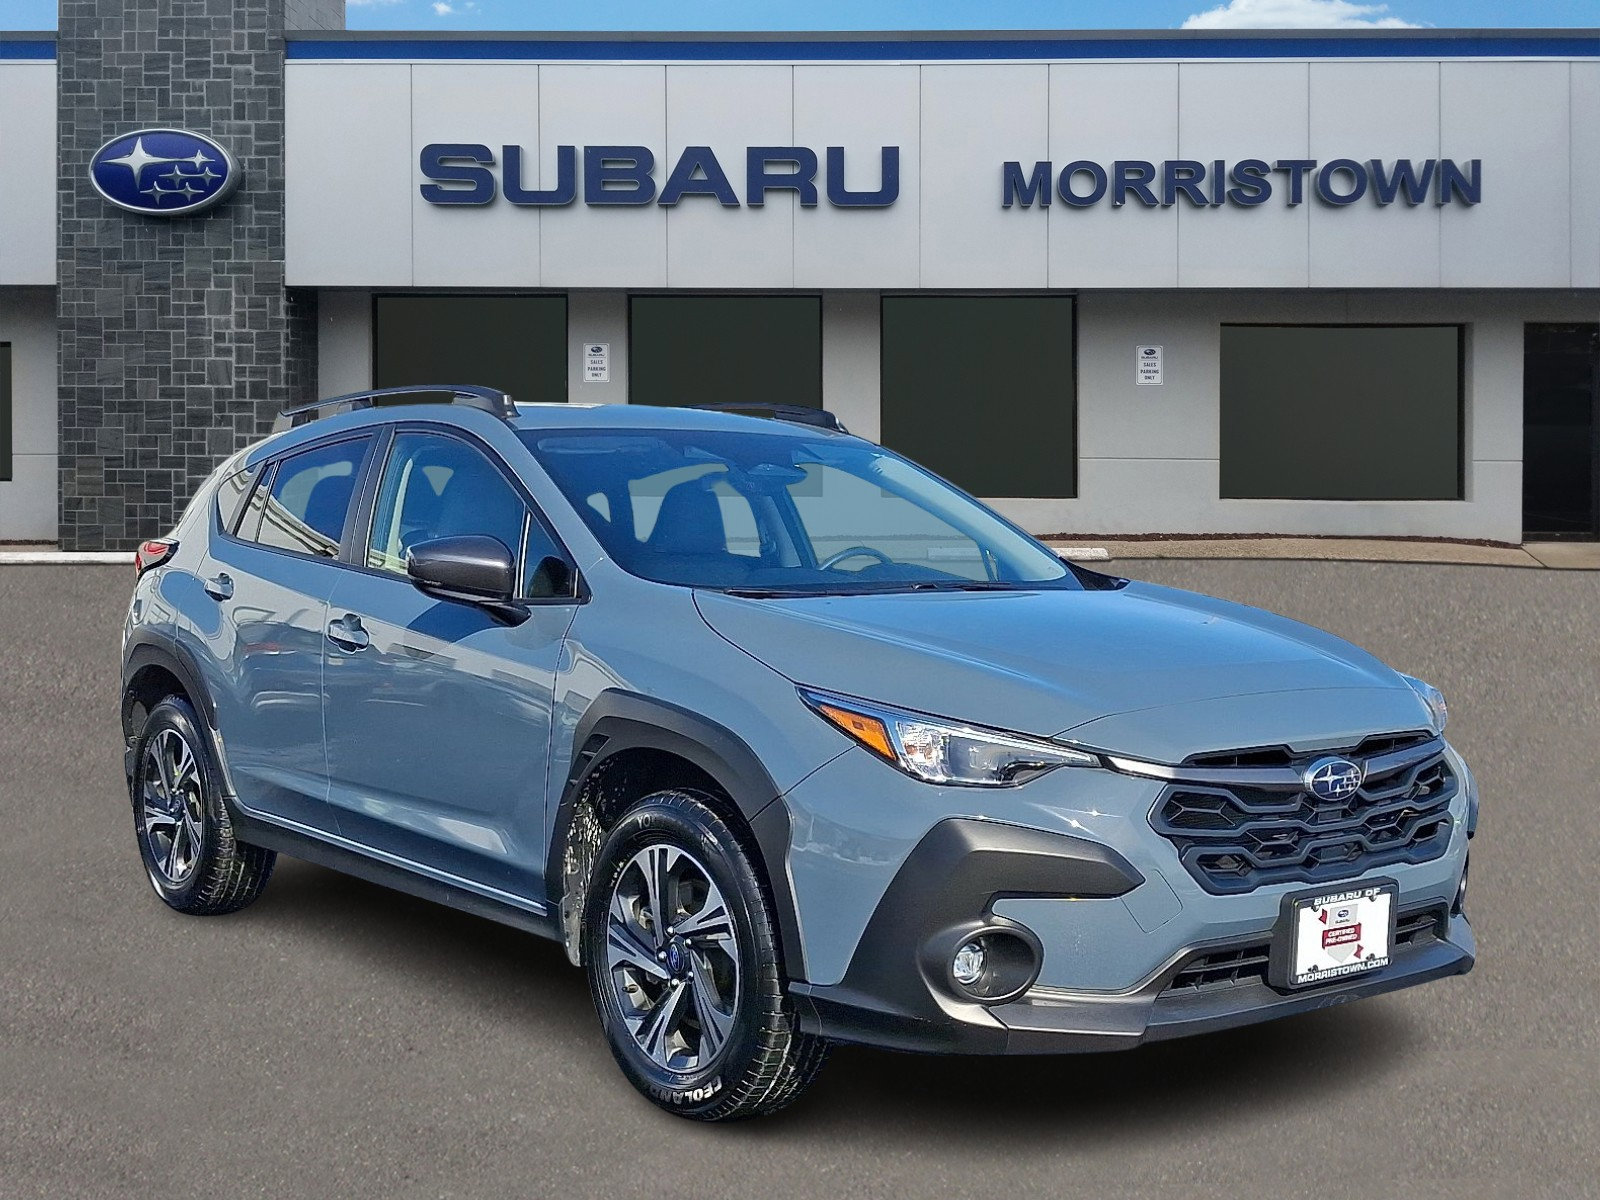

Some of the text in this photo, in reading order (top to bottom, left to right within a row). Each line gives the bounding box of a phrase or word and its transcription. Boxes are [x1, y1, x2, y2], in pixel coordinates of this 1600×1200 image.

[420, 143, 900, 207] SUBARU
[1002, 158, 1482, 208] MORRISTOWN
[1314, 887, 1381, 905] SUBARU OF
[1326, 934, 1358, 944] PRE-OWNED
[1328, 928, 1356, 937] CERTIFIED
[1297, 957, 1389, 984] MORRISTOWN.COM
